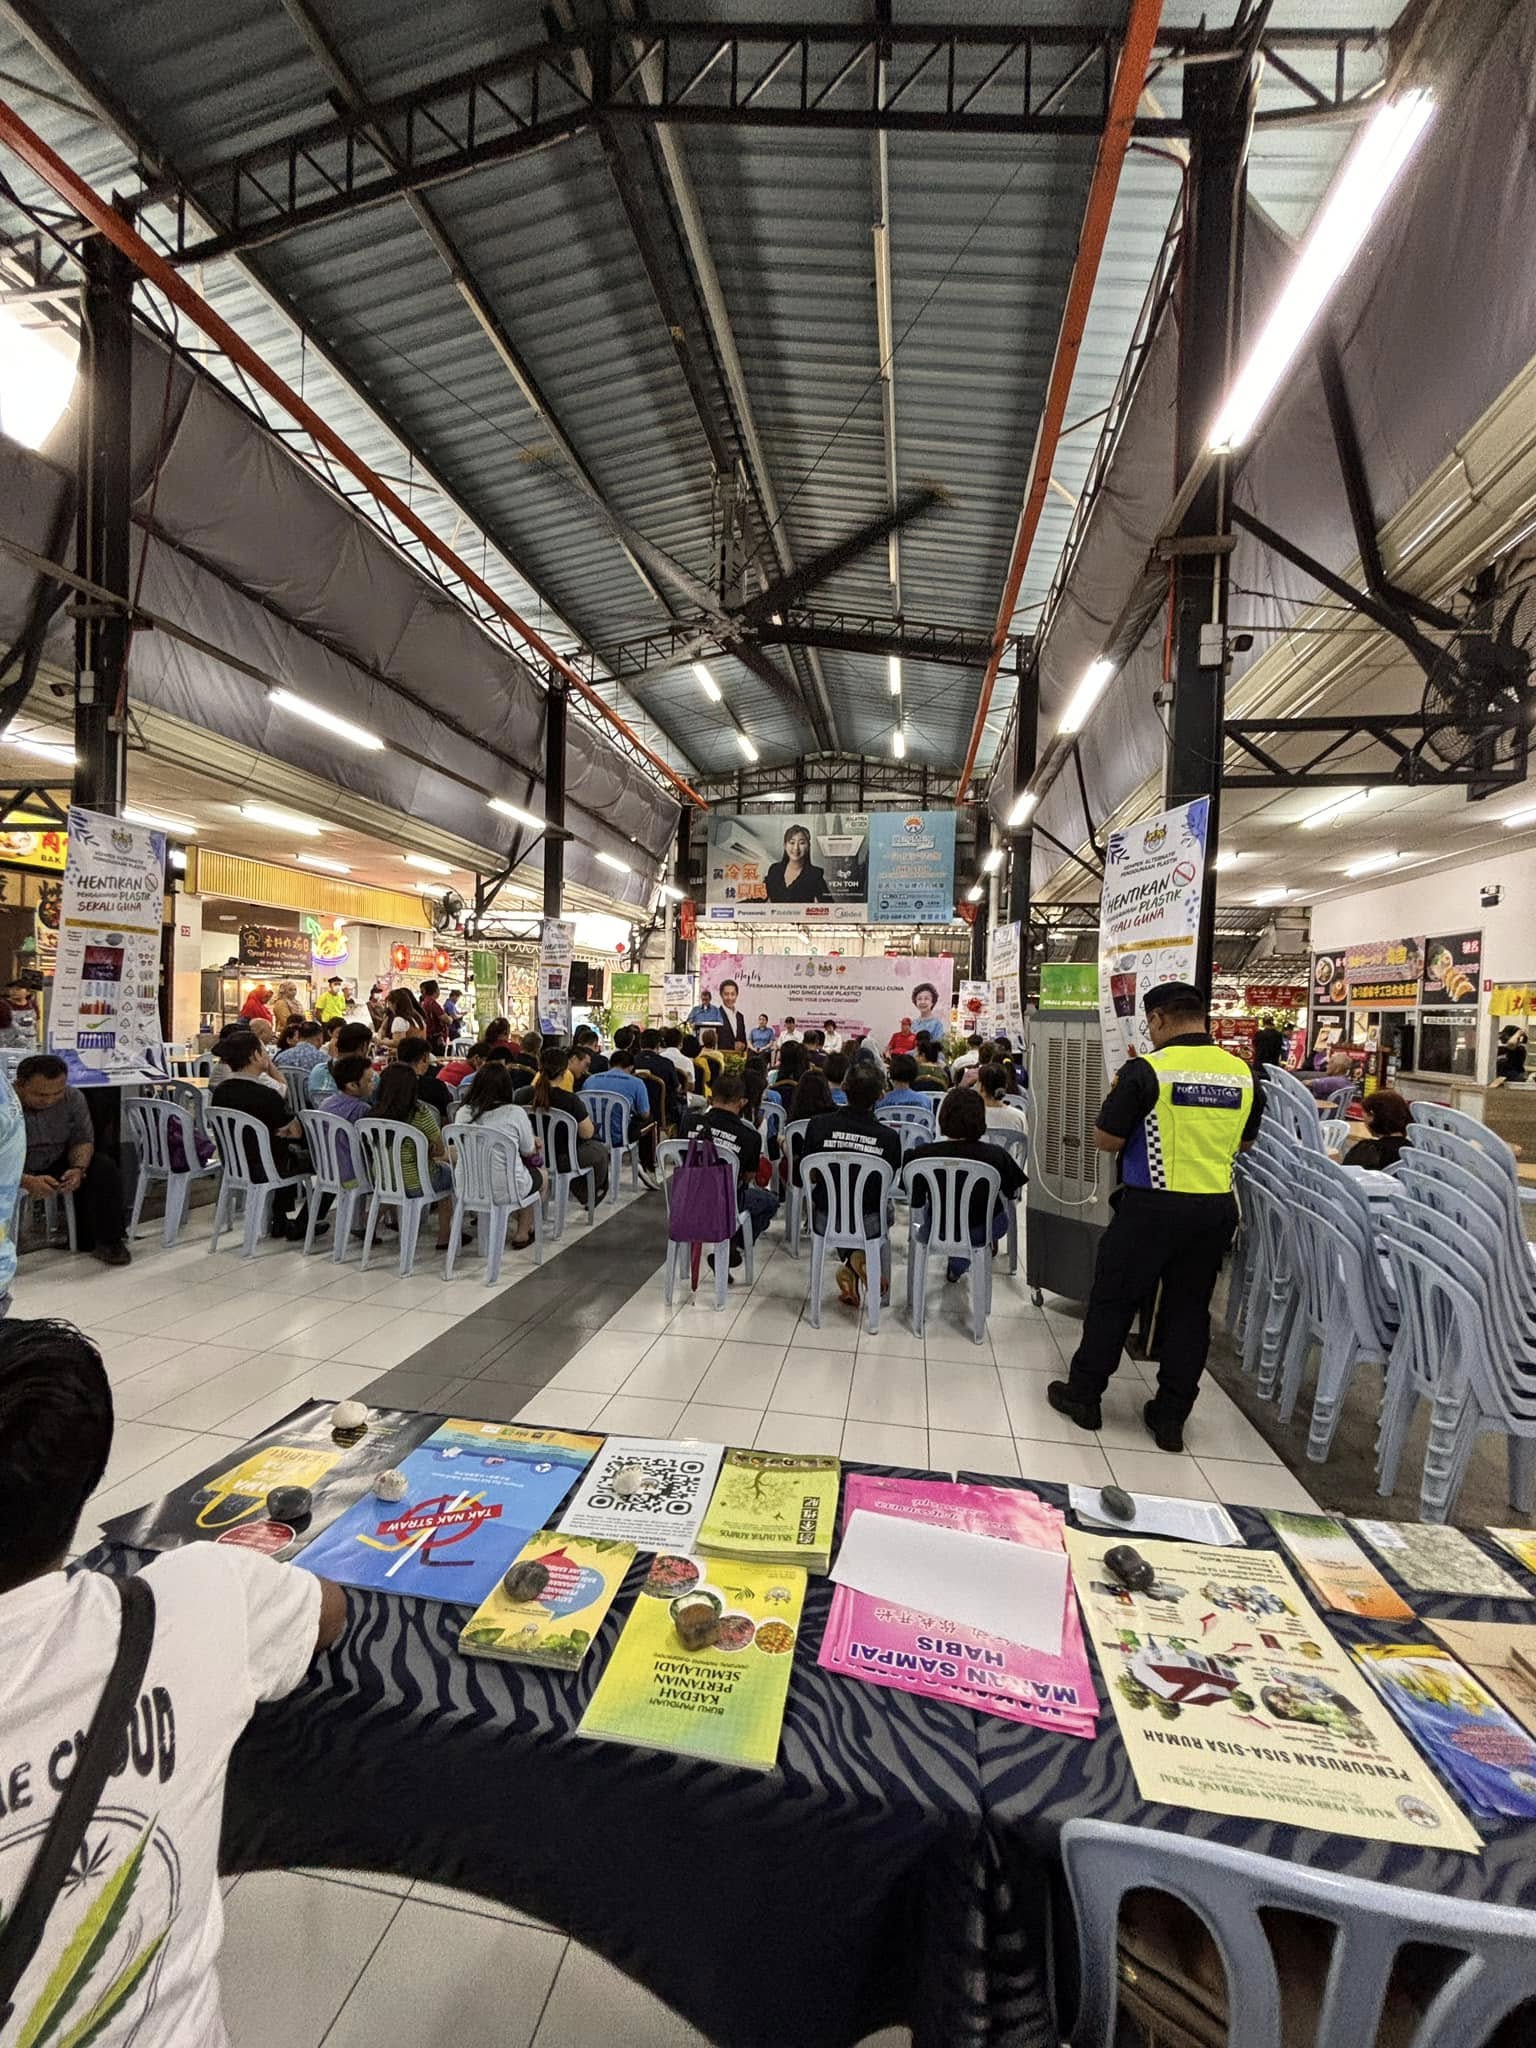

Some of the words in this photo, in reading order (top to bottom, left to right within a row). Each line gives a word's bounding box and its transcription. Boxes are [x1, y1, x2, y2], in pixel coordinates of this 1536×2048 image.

[40, 855, 62, 864] BAK
[77, 874, 143, 891] HENTIKAN
[844, 880, 859, 888] TOH
[1107, 872, 1171, 914] HENTIKAN
[1139, 889, 1182, 914] PLASTIK
[78, 900, 115, 912] SEKALI
[117, 902, 142, 912] GUNA
[1133, 907, 1165, 927] GUNA
[436, 1513, 465, 1525] NAK
[468, 1508, 493, 1520] TAK
[386, 1518, 434, 1532] STRAW
[849, 1643, 957, 1679] SAMPAI
[916, 1636, 1005, 1668] HABIS
[654, 1660, 742, 1682] SEMULAJADI
[653, 1673, 734, 1694] PERTANIAN
[967, 1667, 1078, 1706] MAKAN
[649, 1698, 695, 1712] PANDUAN
[659, 1687, 720, 1706] KAEDAH
[697, 1704, 725, 1716] BUKU
[1142, 1729, 1202, 1755] RUMAH
[1205, 1739, 1291, 1764] SISA-SISA
[1293, 1752, 1412, 1783] PENGURUSAN
